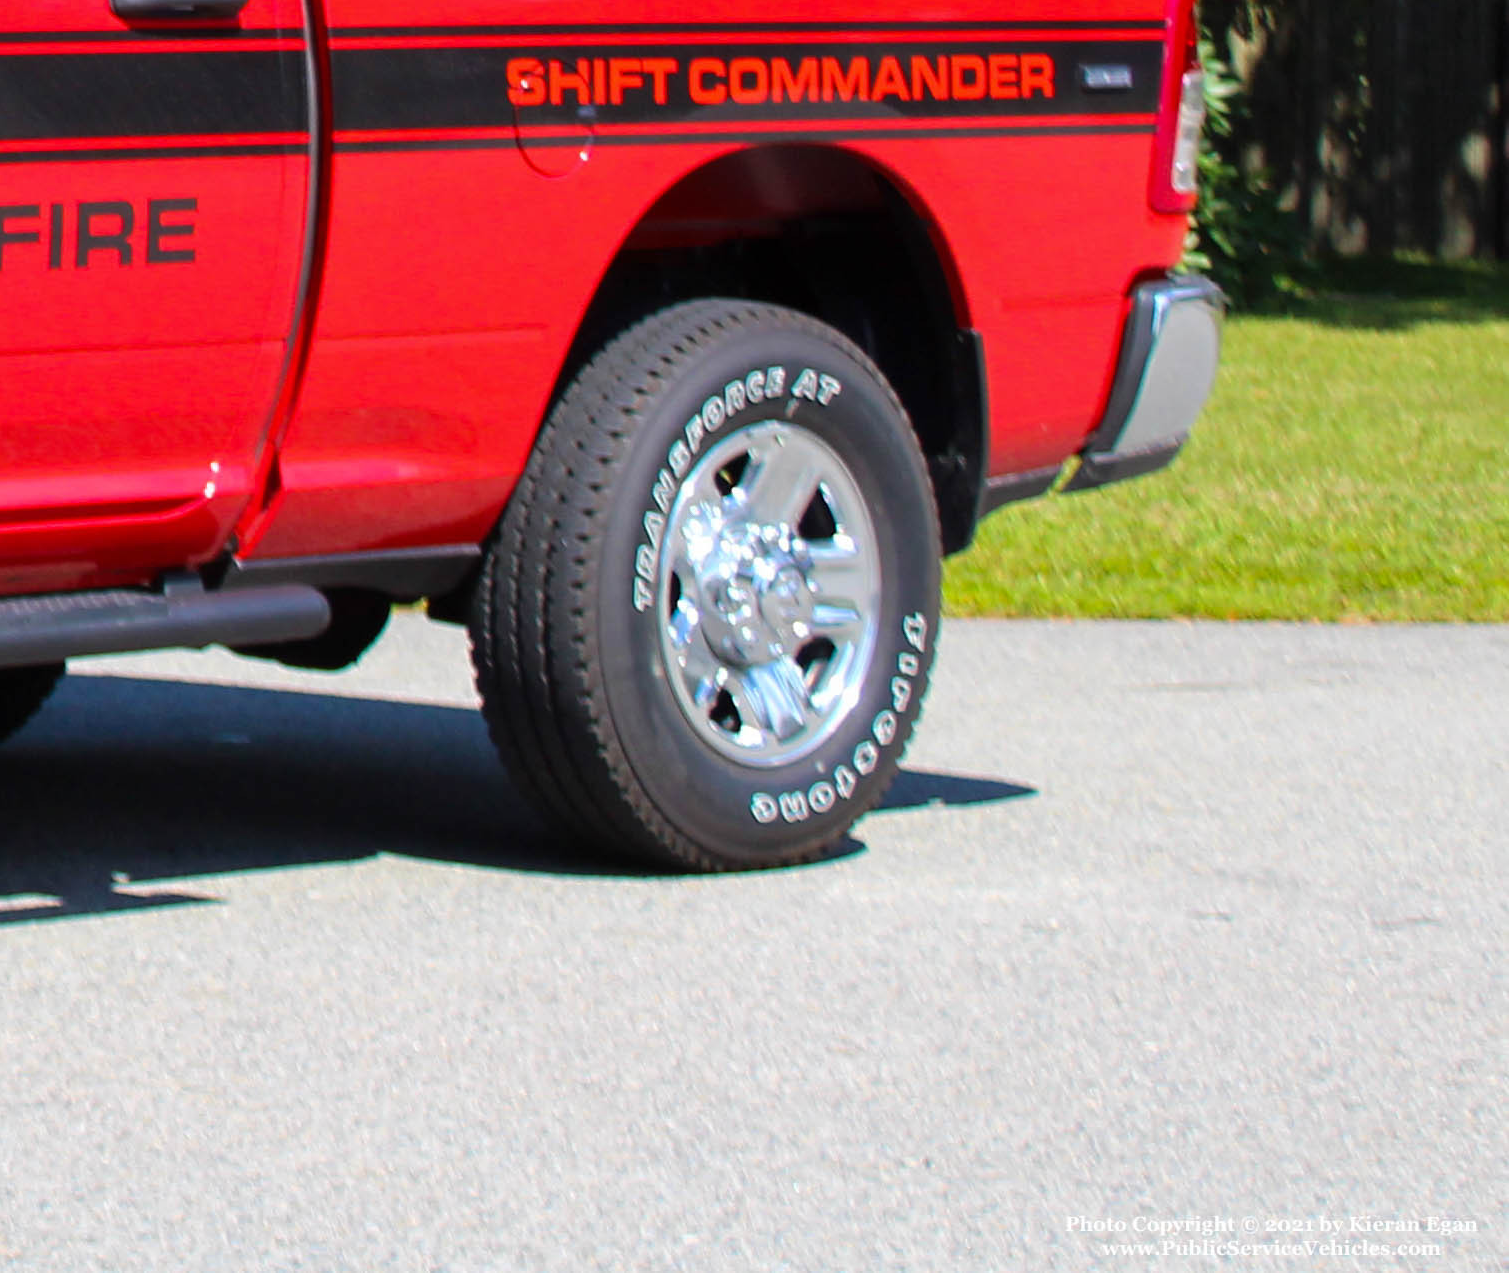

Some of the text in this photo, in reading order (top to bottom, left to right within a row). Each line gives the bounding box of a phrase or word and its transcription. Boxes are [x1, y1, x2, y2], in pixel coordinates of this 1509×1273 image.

[506, 52, 1056, 107] SHIFT COMMANDER
[632, 365, 844, 613] TRANSFORCE AT
